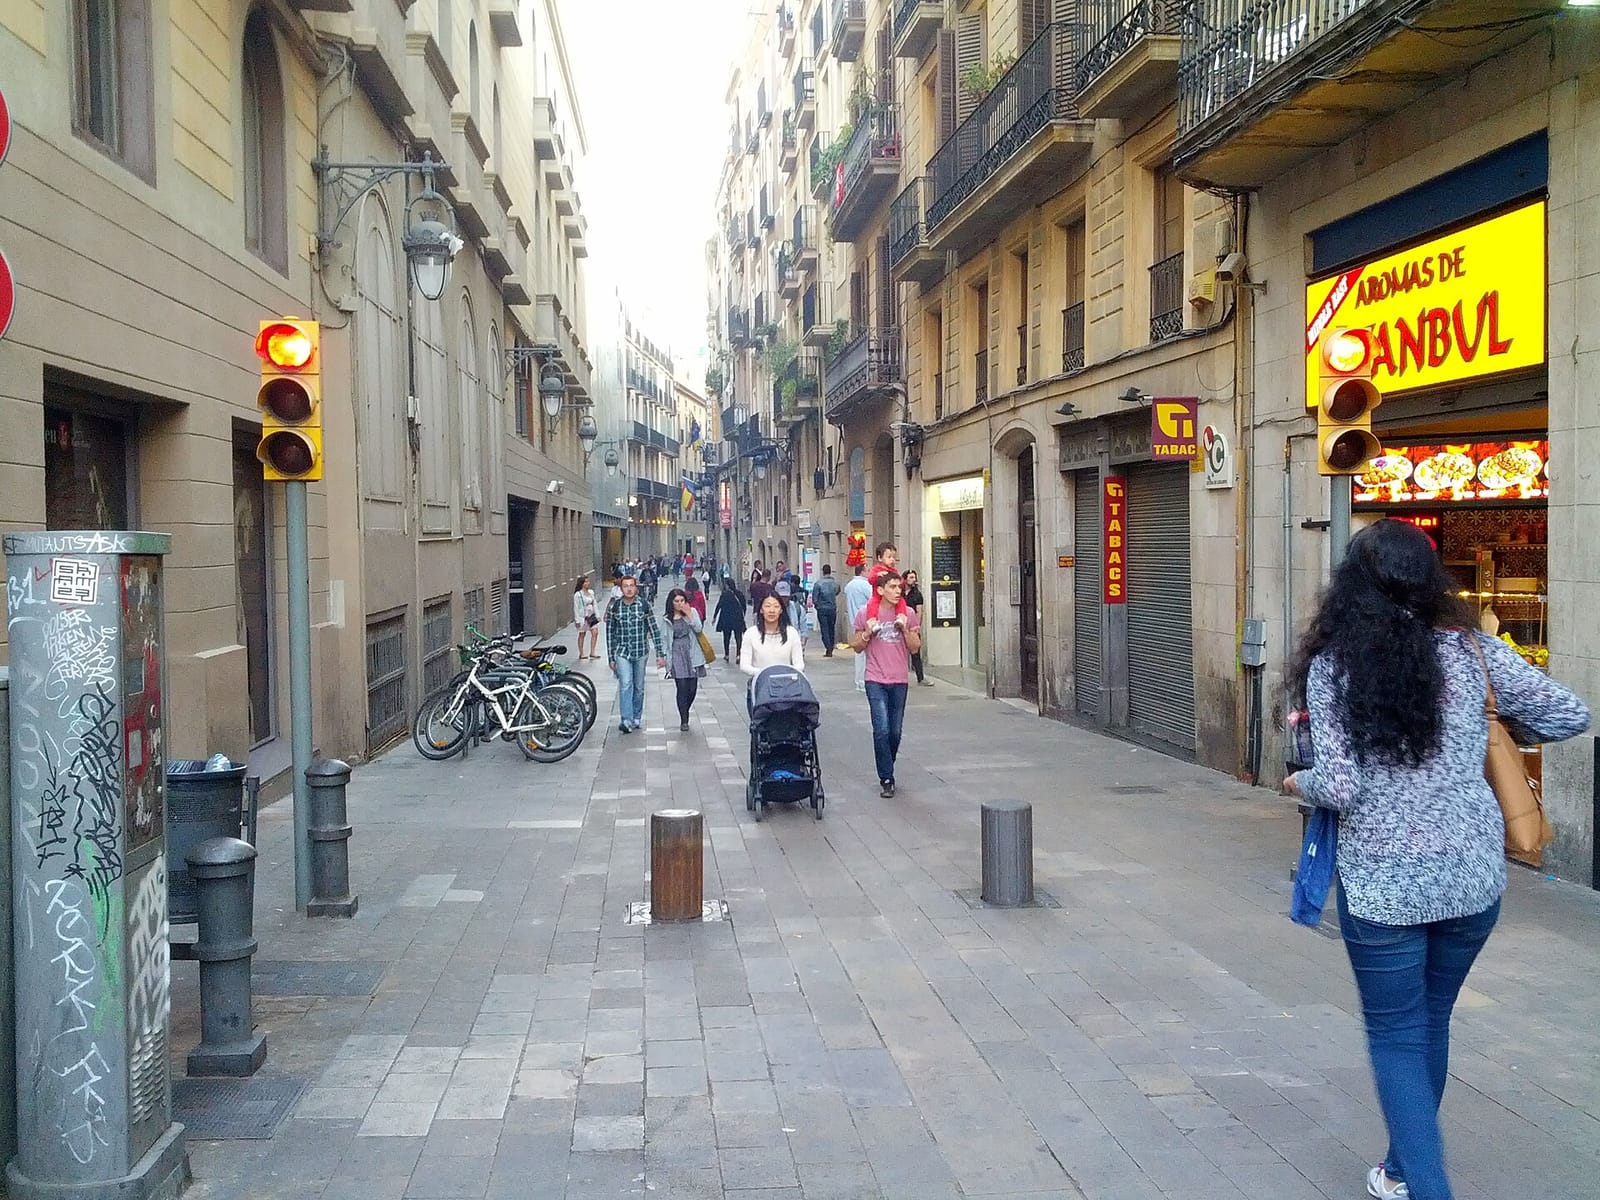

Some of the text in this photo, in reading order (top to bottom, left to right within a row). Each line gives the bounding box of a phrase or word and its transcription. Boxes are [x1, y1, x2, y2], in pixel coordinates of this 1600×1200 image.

[1355, 245, 1466, 309] AROMAS DE
[1153, 444, 1196, 456] TABAC
[1108, 503, 1122, 597] TABACS
